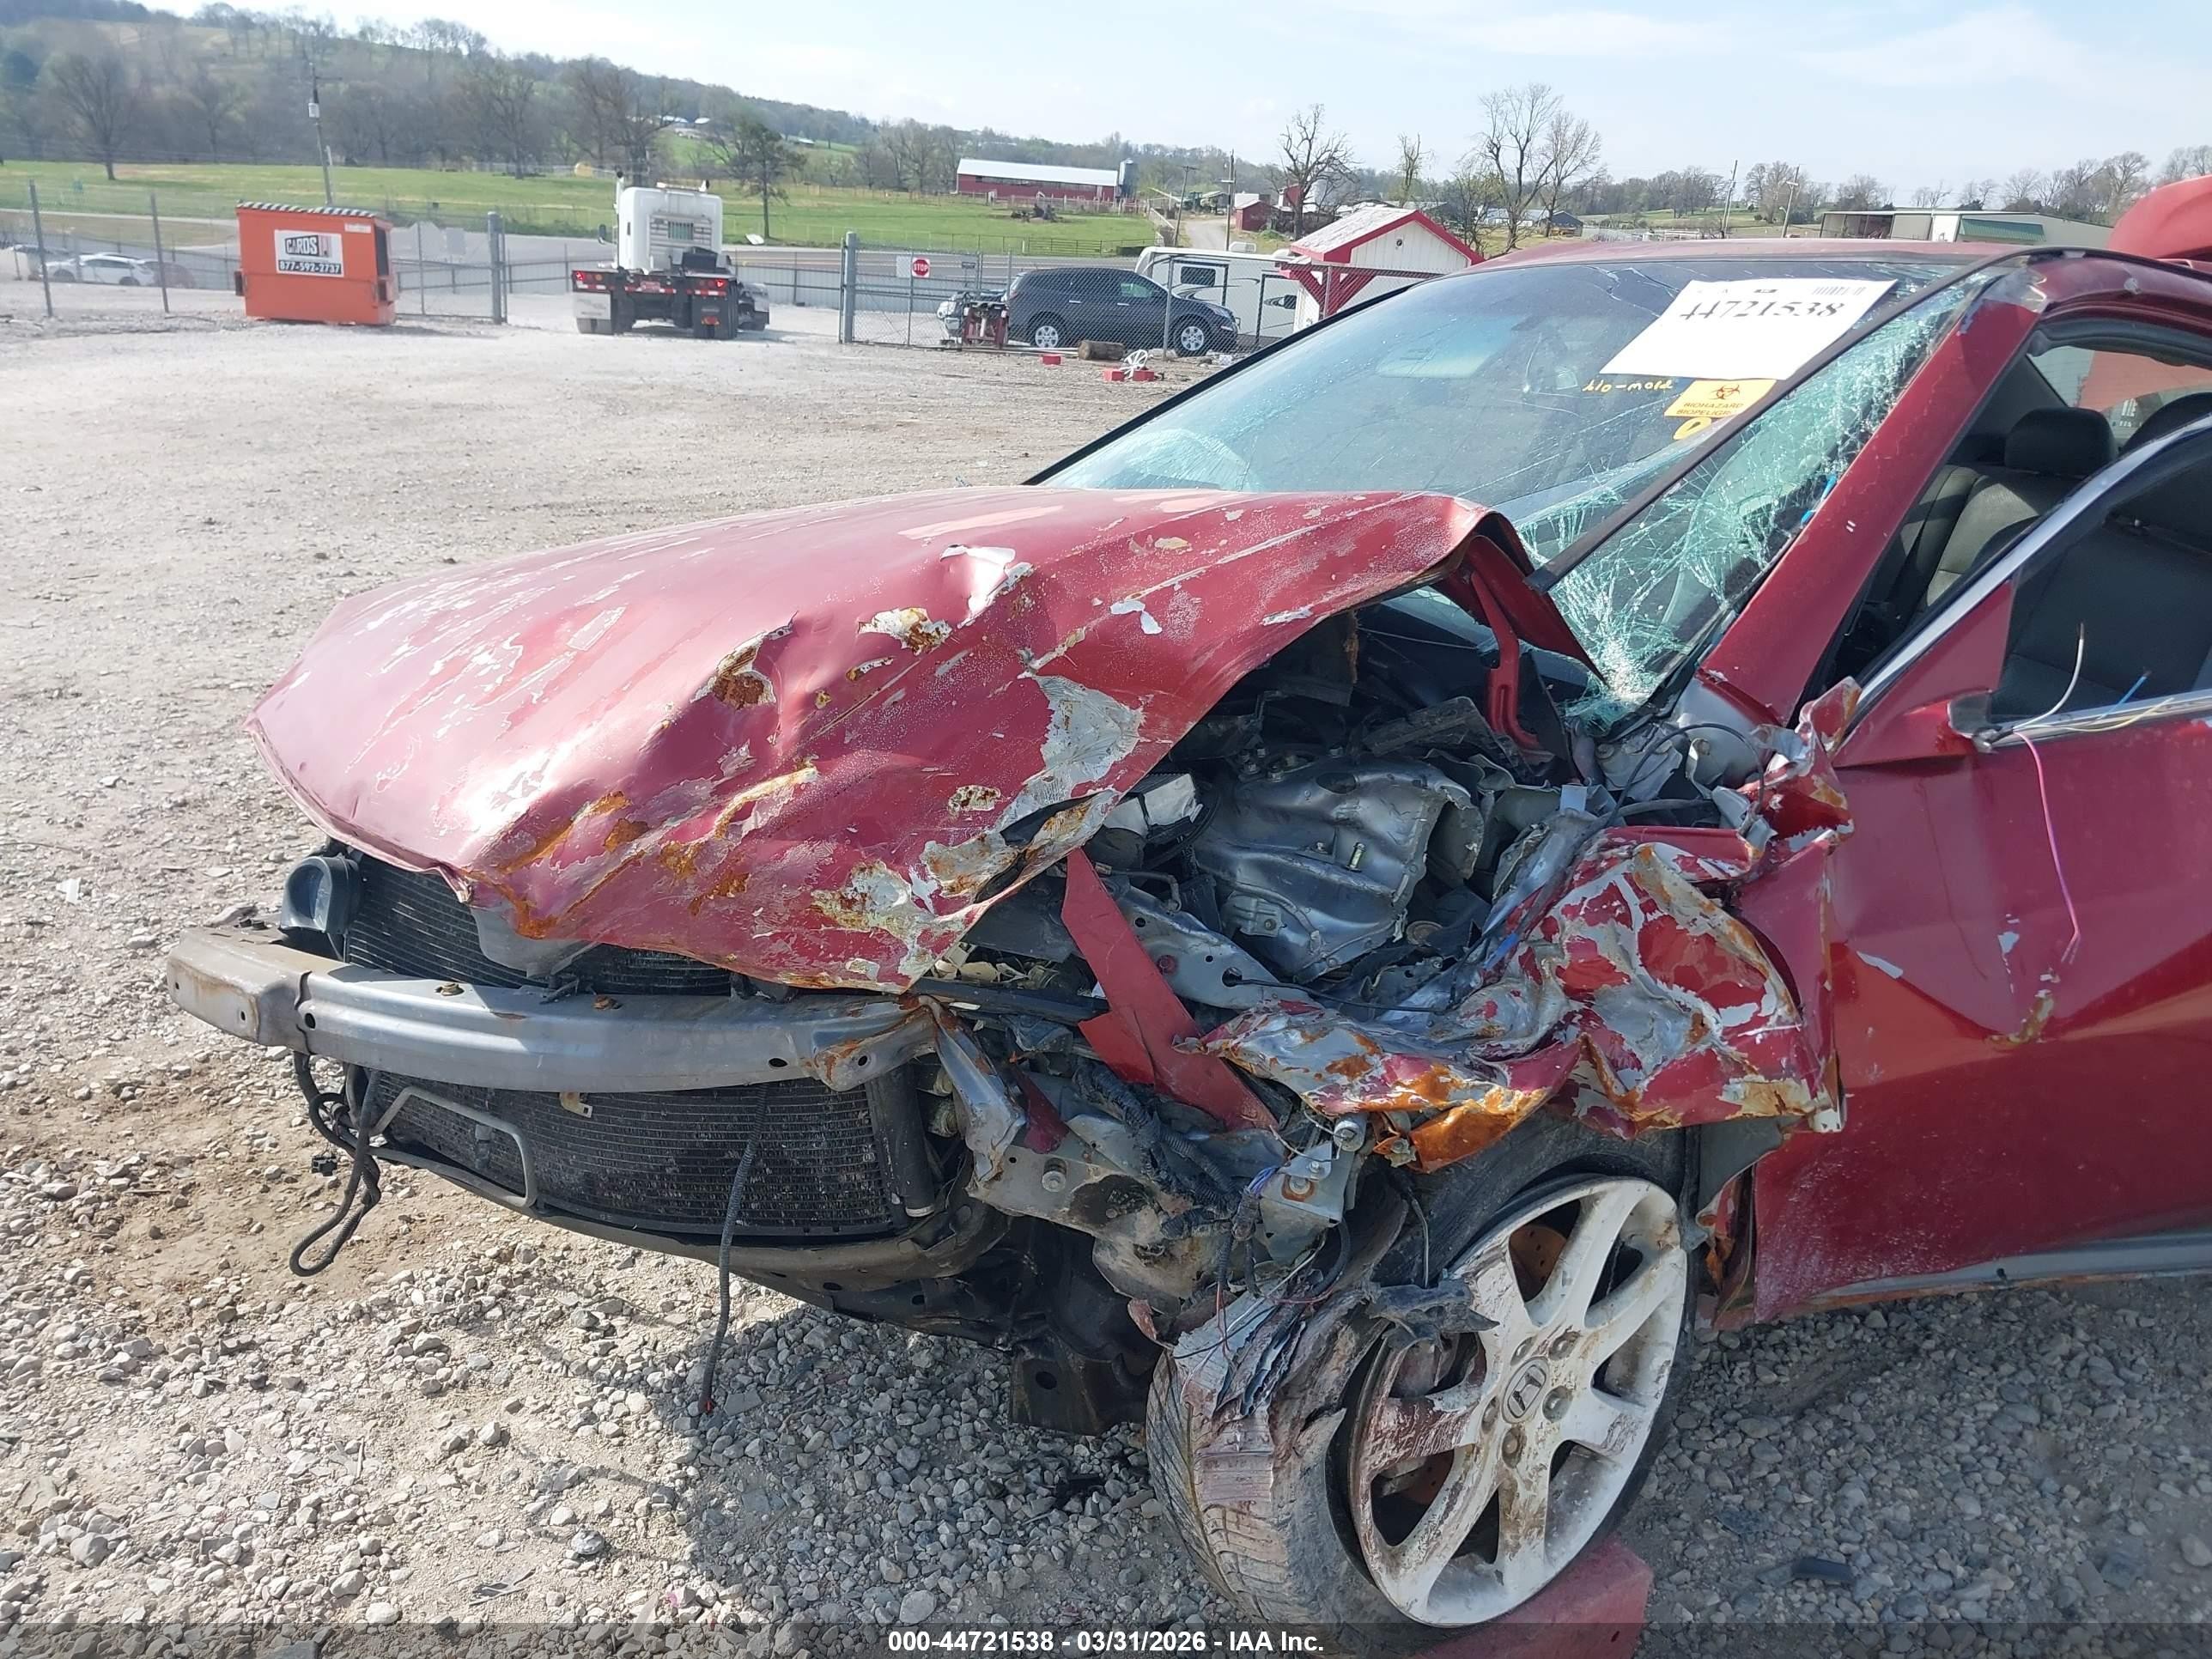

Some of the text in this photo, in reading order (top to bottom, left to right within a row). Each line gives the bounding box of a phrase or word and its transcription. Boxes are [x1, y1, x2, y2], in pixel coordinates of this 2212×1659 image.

[286, 236, 319, 255] CARDS
[279, 261, 340, 273] 877-592-2737
[1680, 301, 1844, 319] 44721538
